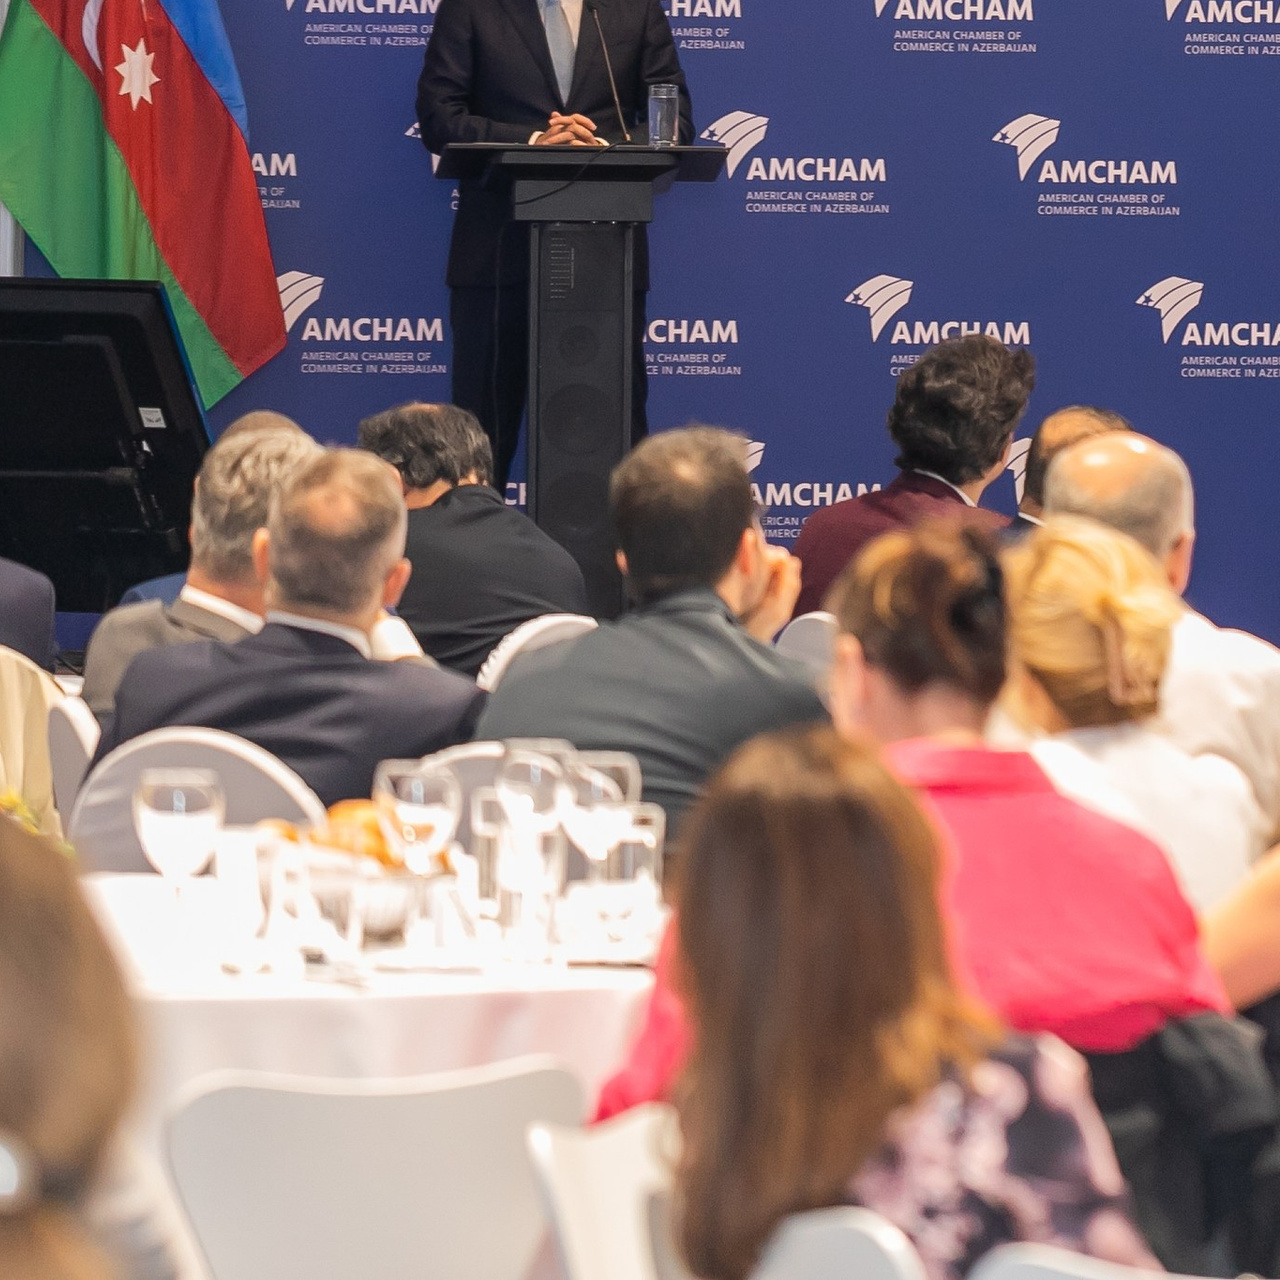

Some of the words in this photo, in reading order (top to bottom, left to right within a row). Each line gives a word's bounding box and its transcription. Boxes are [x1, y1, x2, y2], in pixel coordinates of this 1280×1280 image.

[304, 23, 363, 33] AMERICAN
[364, 24, 418, 34] CHAMBER
[715, 27, 730, 38] OF
[304, 35, 367, 46] COMMERCE
[369, 36, 382, 46] IN
[893, 29, 951, 40] AMERICAN
[952, 30, 1005, 41] CHAMBER
[1007, 31, 1022, 41] OF
[1184, 33, 1241, 43] AMERICAN
[893, 41, 955, 53] COMMERCE
[957, 42, 970, 52] IN
[1184, 44, 1245, 55] COMMERCE
[1247, 45, 1260, 55] IN
[745, 158, 887, 181] AMCHAM
[1037, 161, 1177, 183] AMCHAM
[270, 186, 286, 197] OF
[745, 191, 803, 201] AMERICAN
[804, 191, 858, 202] CHAMBER
[859, 191, 875, 202] OF
[1037, 193, 1094, 203] AMERICAN
[1096, 193, 1149, 204] CHAMBER
[1150, 193, 1166, 204] OF
[745, 202, 808, 213] COMMERCE
[809, 203, 822, 213] IN
[1037, 205, 1099, 216] COMMERCE
[1101, 206, 1113, 215] IN
[303, 318, 444, 340] AMCHAM
[644, 319, 739, 343] CHAM
[301, 351, 359, 361] AMERICAN
[361, 351, 414, 362] CHAMBER
[417, 352, 432, 362] OF
[657, 353, 710, 363] CHAMBER
[711, 353, 727, 363] OF
[1180, 356, 1238, 366] AMERICAN
[300, 363, 363, 374] COMMERCE
[365, 364, 378, 373] IN
[661, 365, 673, 375] IN
[1180, 367, 1242, 378] COMMERCE
[1244, 368, 1256, 378] IN
